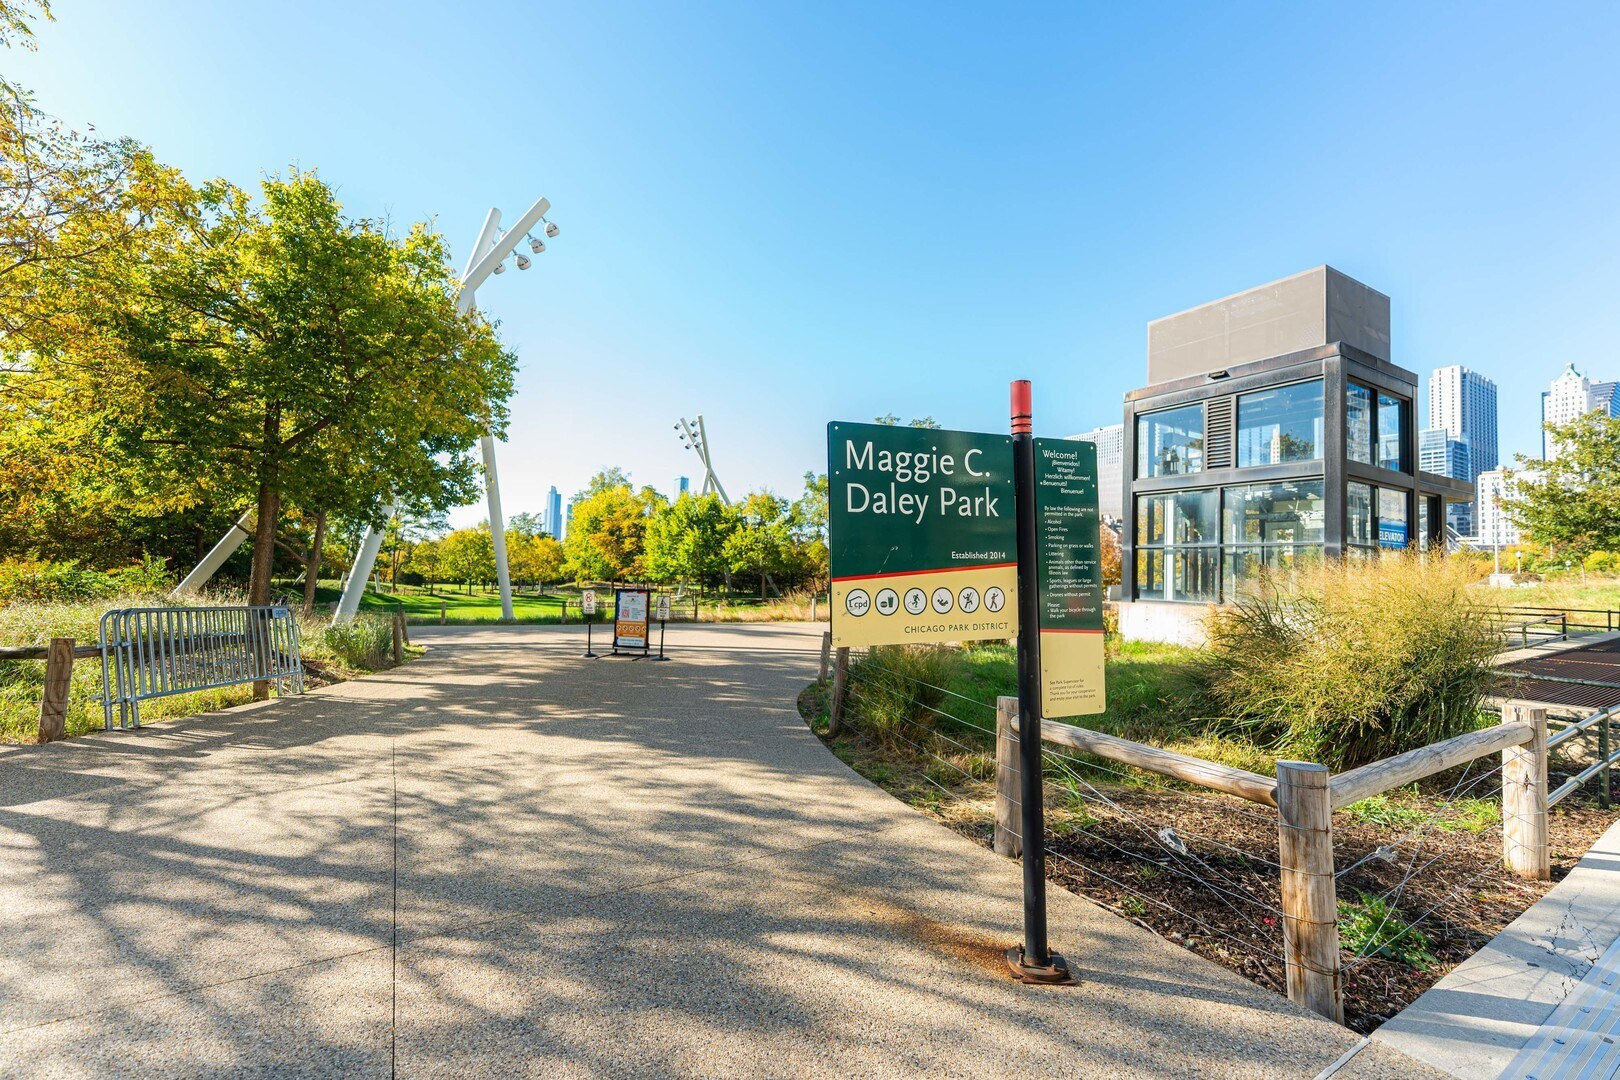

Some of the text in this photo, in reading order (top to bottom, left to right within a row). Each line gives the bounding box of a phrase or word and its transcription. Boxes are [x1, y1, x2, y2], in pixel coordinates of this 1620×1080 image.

[1042, 449, 1078, 460] Welcome!
[846, 439, 991, 484] Maggie C.
[1064, 474, 1091, 482] willkommen!
[847, 482, 999, 525] Daley Park
[1379, 530, 1405, 543] ELEVATOR
[951, 551, 1006, 560] Established 2014
[854, 600, 868, 610] cpd
[904, 622, 1009, 634] CHICAGO PARK DISTRICT
